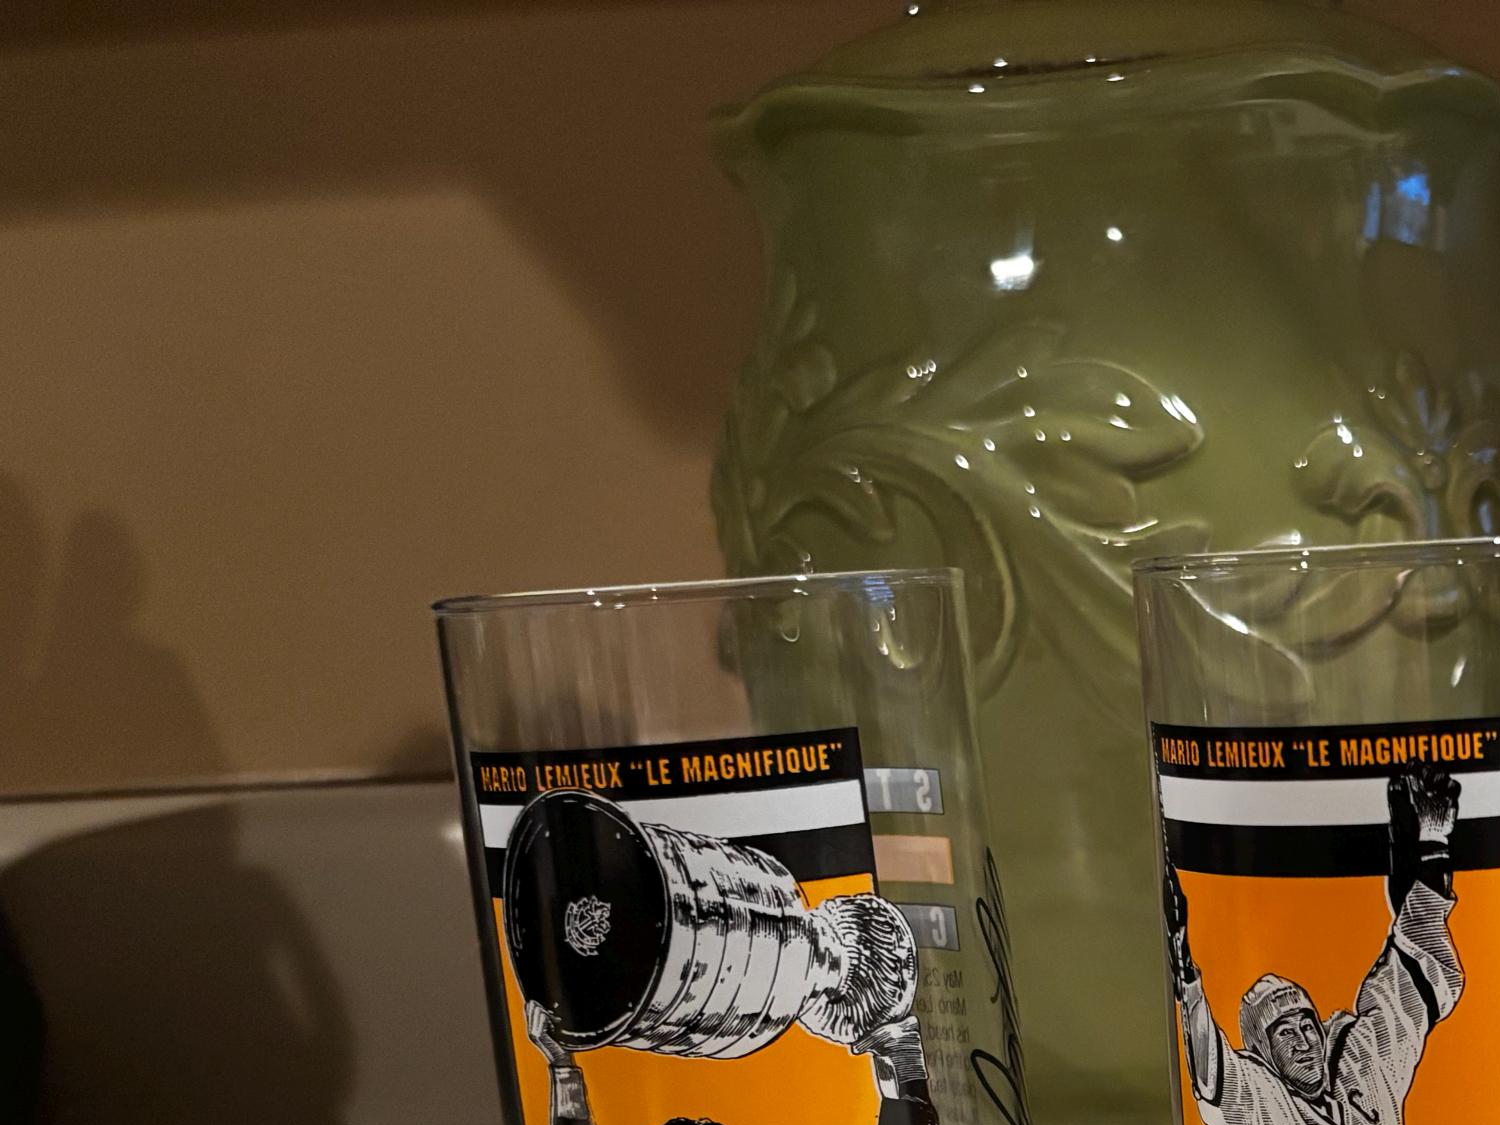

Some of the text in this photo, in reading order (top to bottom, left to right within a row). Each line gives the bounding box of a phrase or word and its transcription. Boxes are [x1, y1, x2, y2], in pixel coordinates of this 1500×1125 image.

[1161, 738, 1200, 767] MARIO
[1207, 741, 1285, 768] LEMIEUX
[480, 766, 527, 792] MARIO
[536, 761, 622, 793] LEMIEUX
